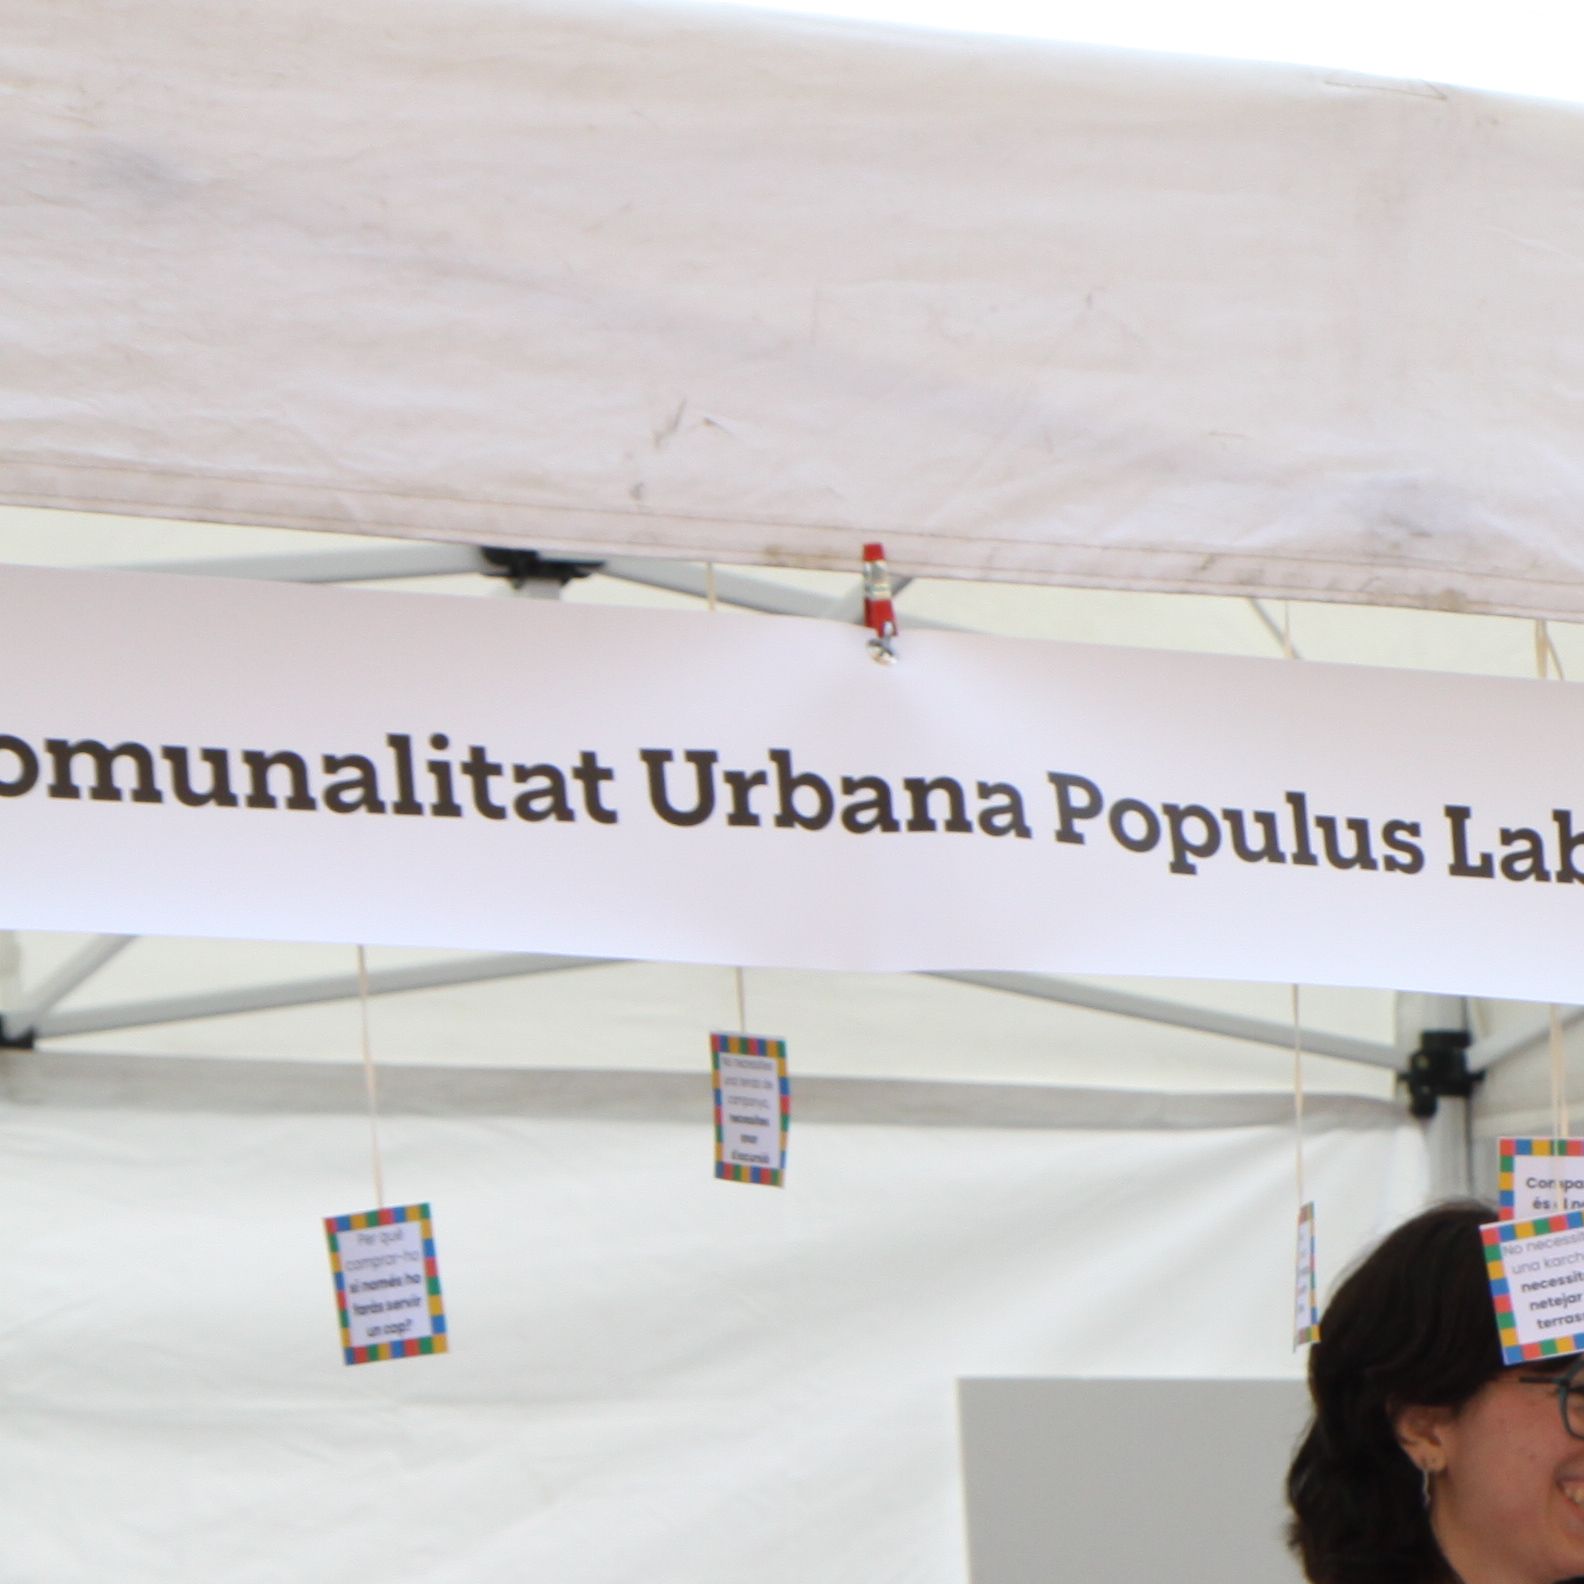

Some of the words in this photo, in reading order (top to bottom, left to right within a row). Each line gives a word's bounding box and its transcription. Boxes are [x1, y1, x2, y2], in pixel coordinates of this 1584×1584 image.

[640, 748, 1032, 839] Urbana
[1047, 771, 1425, 876] Populus
[1503, 1243, 1524, 1257] No
[1511, 1261, 1540, 1276] una
[1529, 1290, 1583, 1313] netejar
